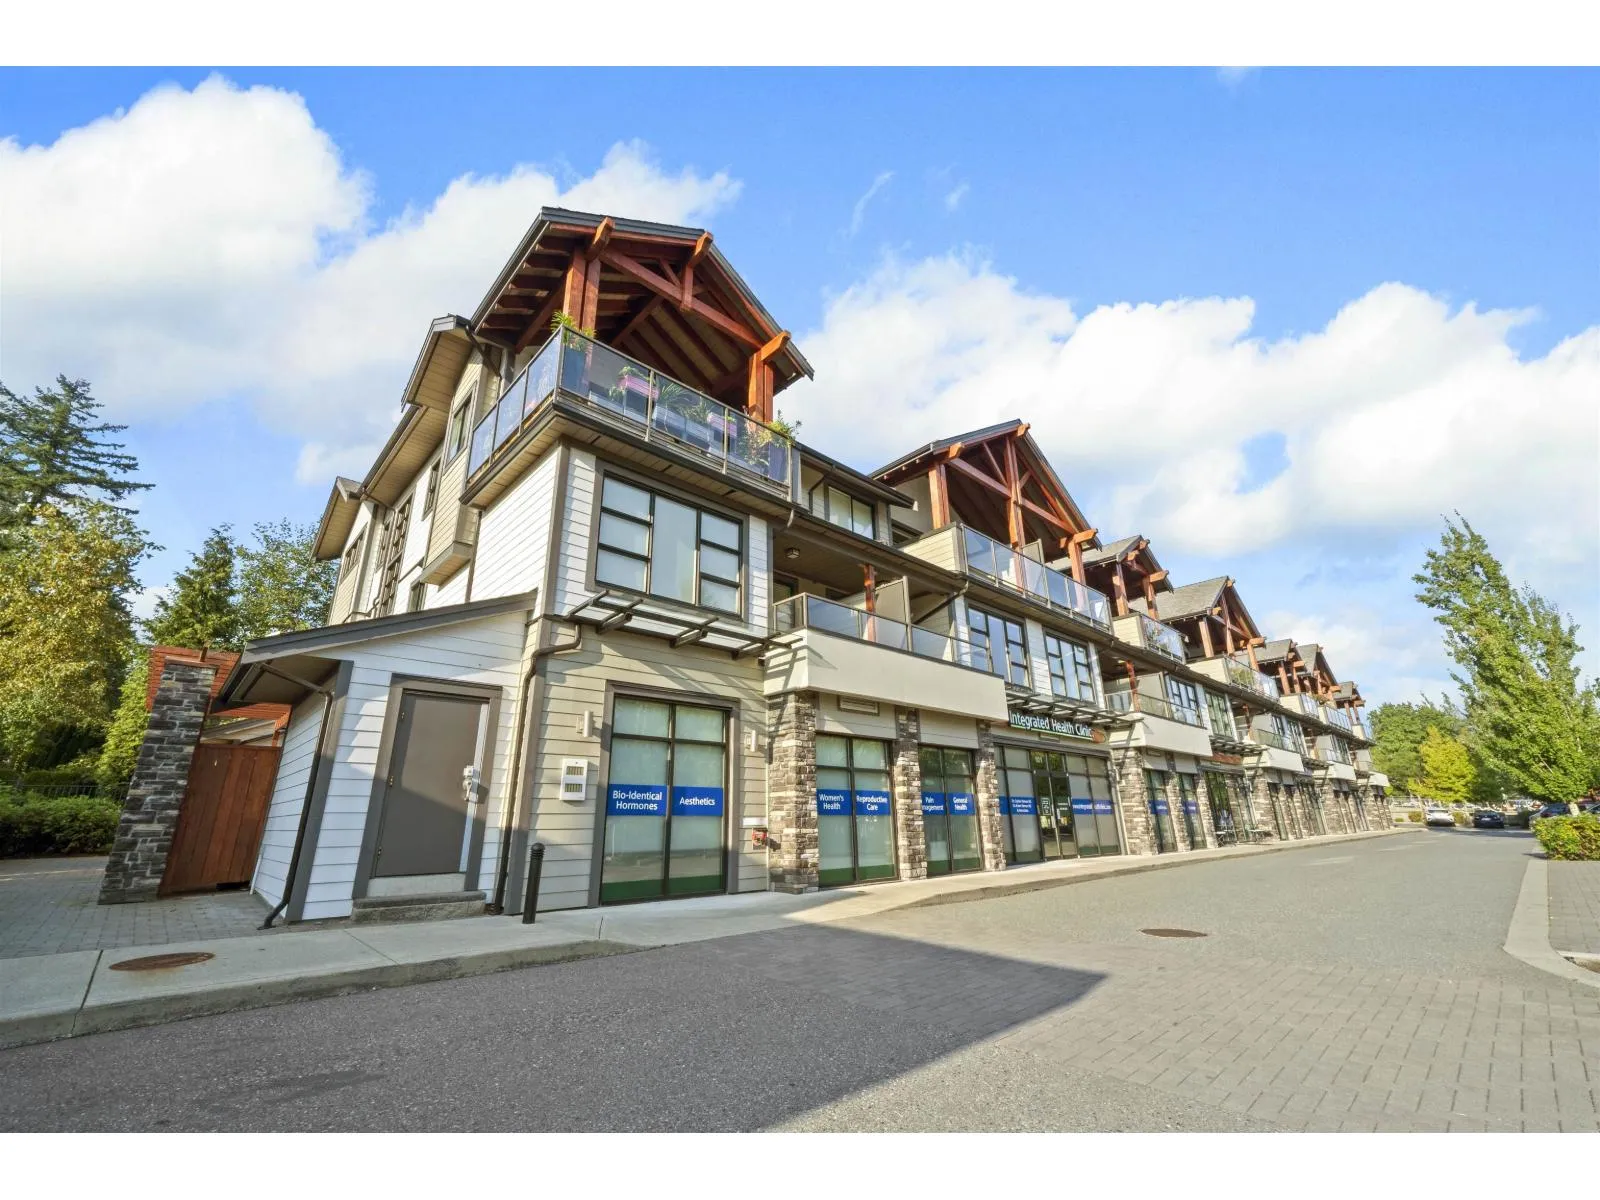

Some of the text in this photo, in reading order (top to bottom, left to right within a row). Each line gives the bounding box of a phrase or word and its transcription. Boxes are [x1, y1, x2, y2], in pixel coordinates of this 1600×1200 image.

[1010, 711, 1092, 737] Integrated Health Clinic
[612, 790, 662, 801] Bio-Identical
[818, 793, 845, 802] Women's
[856, 794, 888, 804] Reproductive
[615, 800, 658, 810] Hormones
[679, 796, 716, 806] Aesthetics
[823, 802, 841, 810] Health
[866, 803, 879, 811] Care
